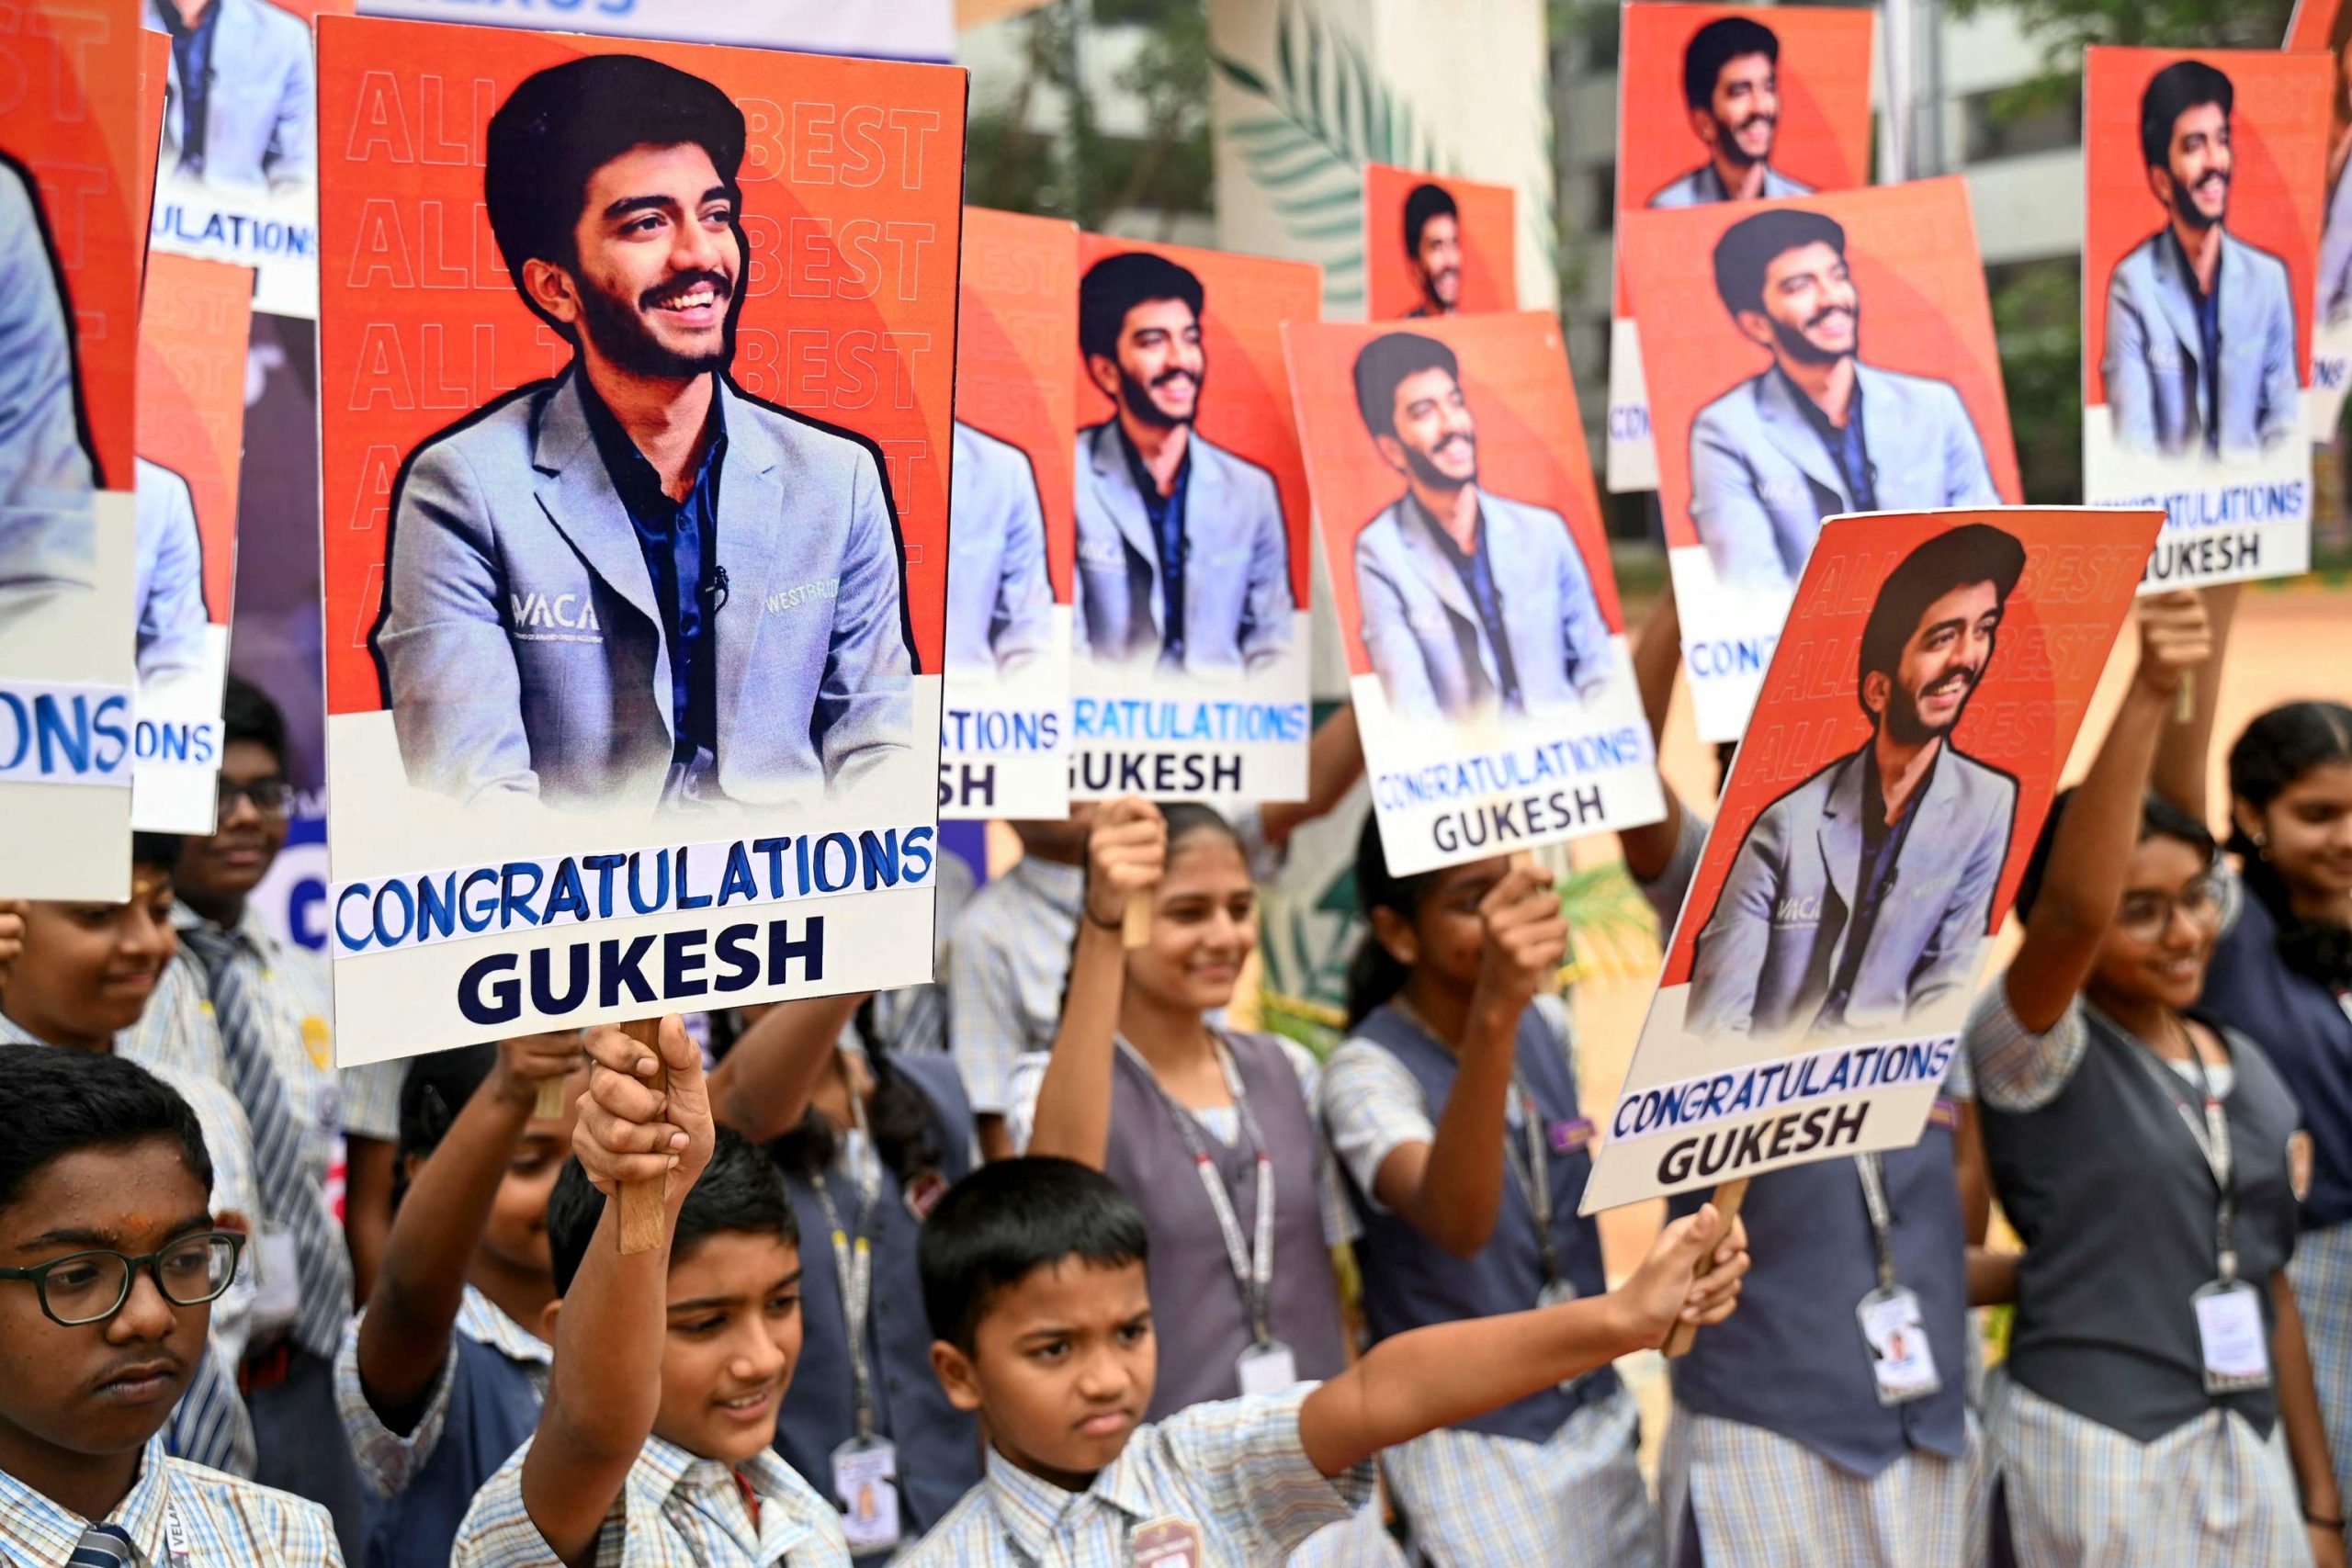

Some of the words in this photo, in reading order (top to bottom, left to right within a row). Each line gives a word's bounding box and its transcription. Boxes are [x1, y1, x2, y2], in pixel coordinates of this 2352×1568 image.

[735, 97, 941, 190] BEST
[153, 206, 314, 254] ULATION
[346, 198, 518, 289] ALL
[739, 214, 935, 301] BEST
[348, 324, 516, 411] ALL
[731, 328, 931, 410] BEST
[2093, 479, 2302, 527] ATULATIONS
[2006, 545, 2143, 604] BEST
[2142, 534, 2259, 581] UKESH
[765, 577, 841, 615] WESTBRID
[1690, 635, 1777, 678] CON
[1980, 624, 2110, 683] BEST
[941, 710, 1057, 750] TIONS
[1069, 751, 1243, 793] UKESH
[1433, 784, 1605, 852] GUKESH
[334, 826, 935, 952] CONGRATULATIONS
[458, 916, 824, 1026] GUKESH
[1613, 1038, 1956, 1139] CONGRATULATIONS
[1657, 1101, 1871, 1186] GUKESH
[167, 1495, 185, 1547] VELAM
